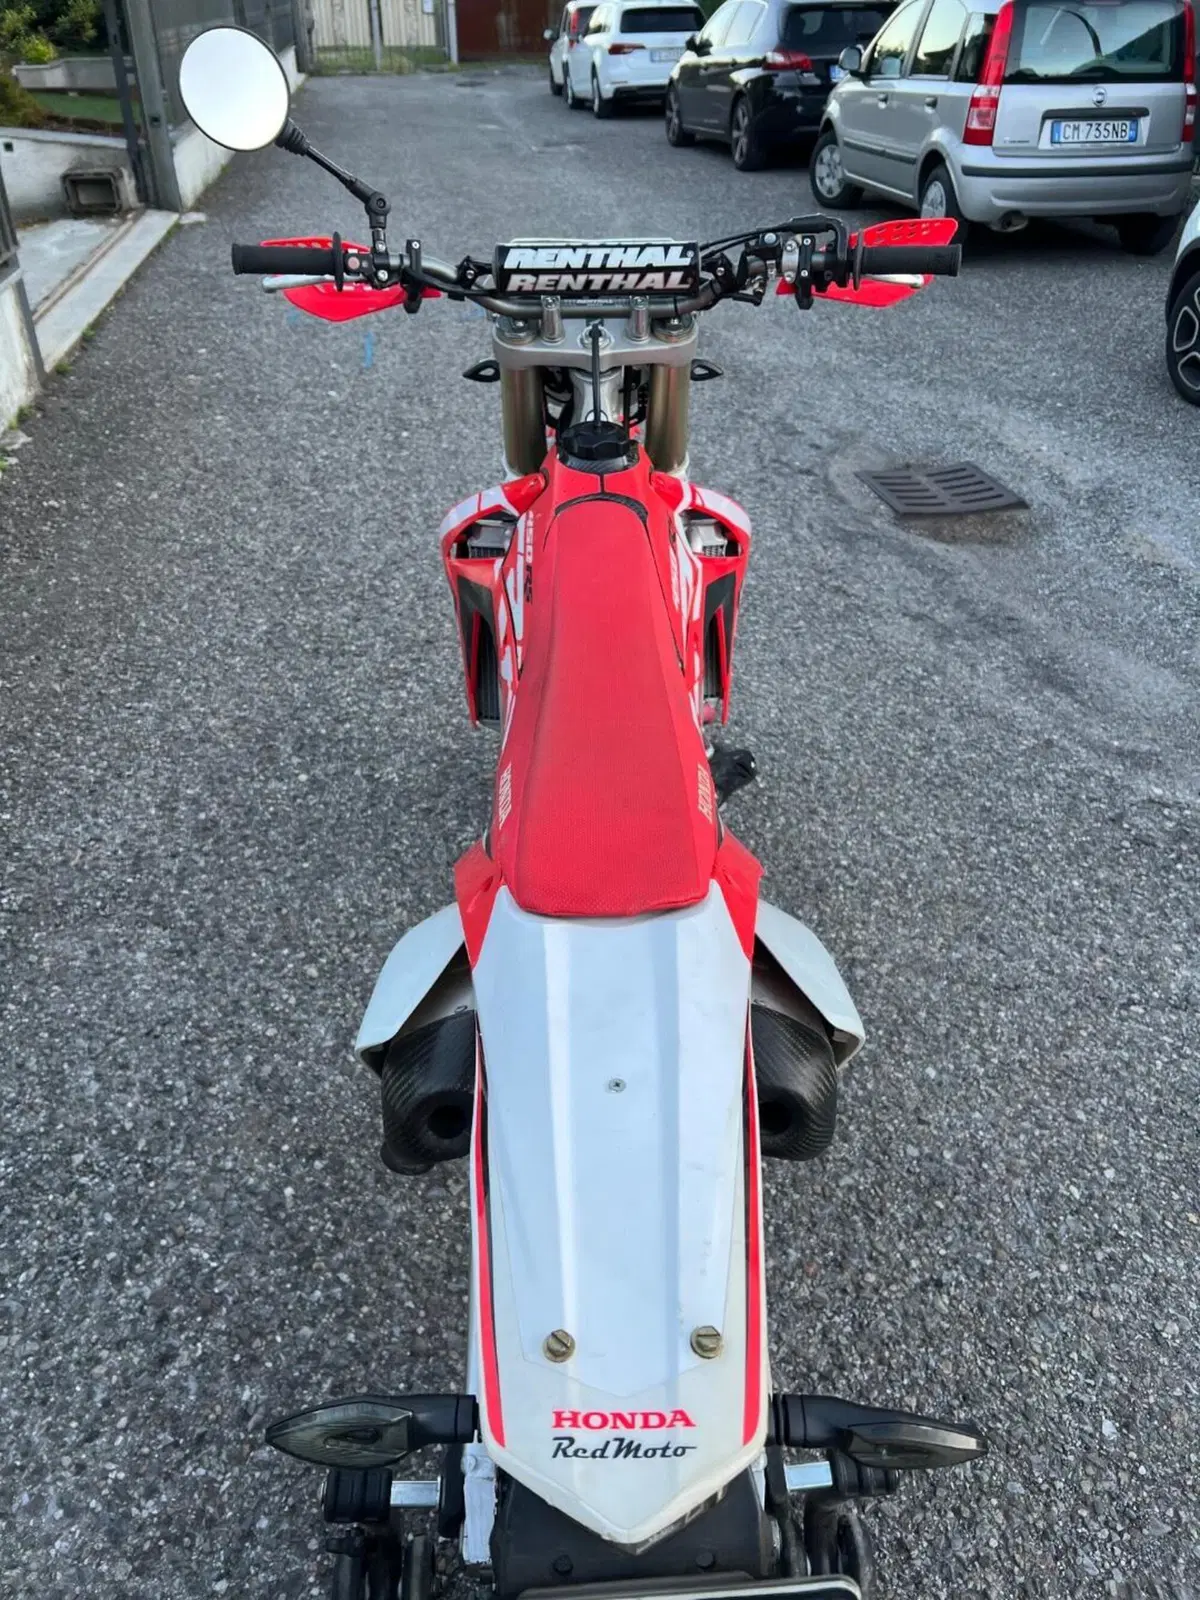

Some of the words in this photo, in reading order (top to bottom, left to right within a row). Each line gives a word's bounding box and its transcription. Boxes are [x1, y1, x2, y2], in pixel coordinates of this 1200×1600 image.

[1062, 124, 1080, 140] CM
[1085, 122, 1128, 139] 735NB
[503, 246, 693, 269] RENTHAL
[506, 271, 691, 292] RENTHAL
[552, 1409, 696, 1429] HONDA
